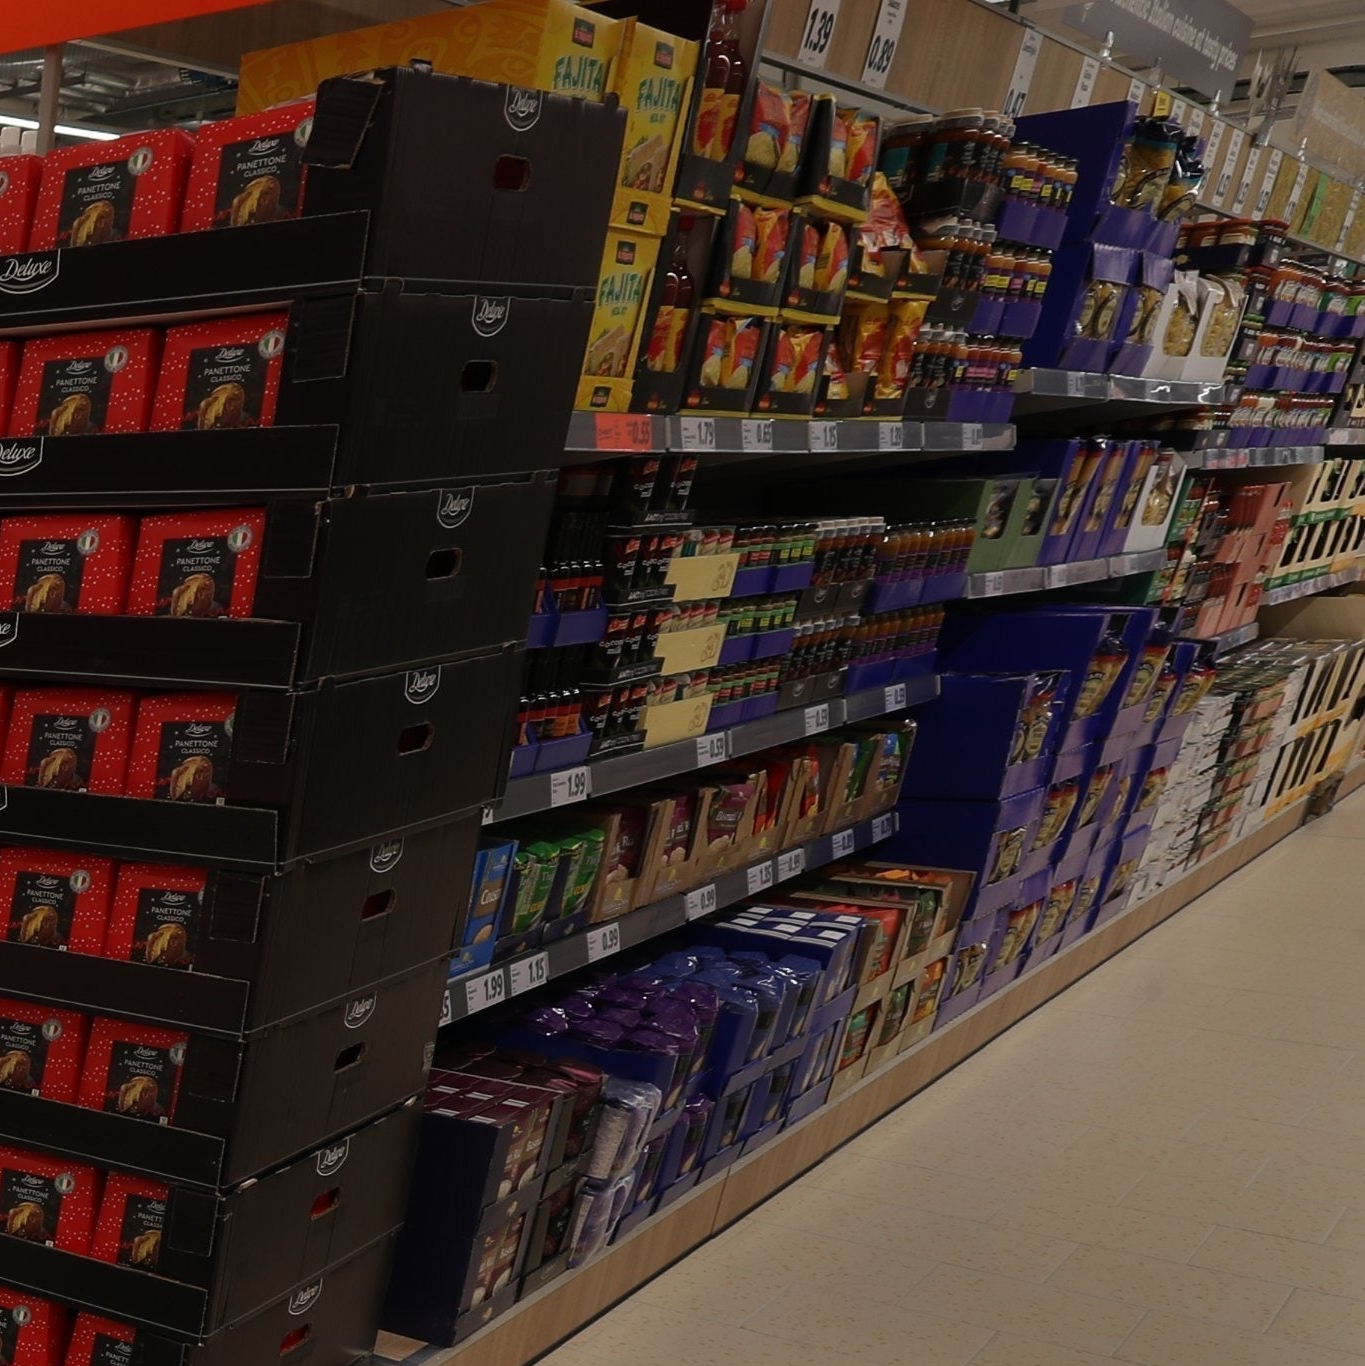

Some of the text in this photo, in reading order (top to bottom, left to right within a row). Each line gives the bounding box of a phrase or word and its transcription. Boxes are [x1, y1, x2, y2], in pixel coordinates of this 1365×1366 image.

[803, 9, 834, 50] 1.39
[869, 36, 895, 73] 0.89
[237, 155, 287, 171] PANETTONE
[244, 165, 278, 178] CLASSICO
[76, 182, 123, 197] PANETTONE
[2, 256, 53, 285] Deluxe
[201, 365, 252, 380] PANETTONE
[568, 770, 586, 796] 1.99
[602, 929, 619, 951] 0.99
[528, 962, 545, 982] 1.15
[484, 979, 503, 1001] 1.99
